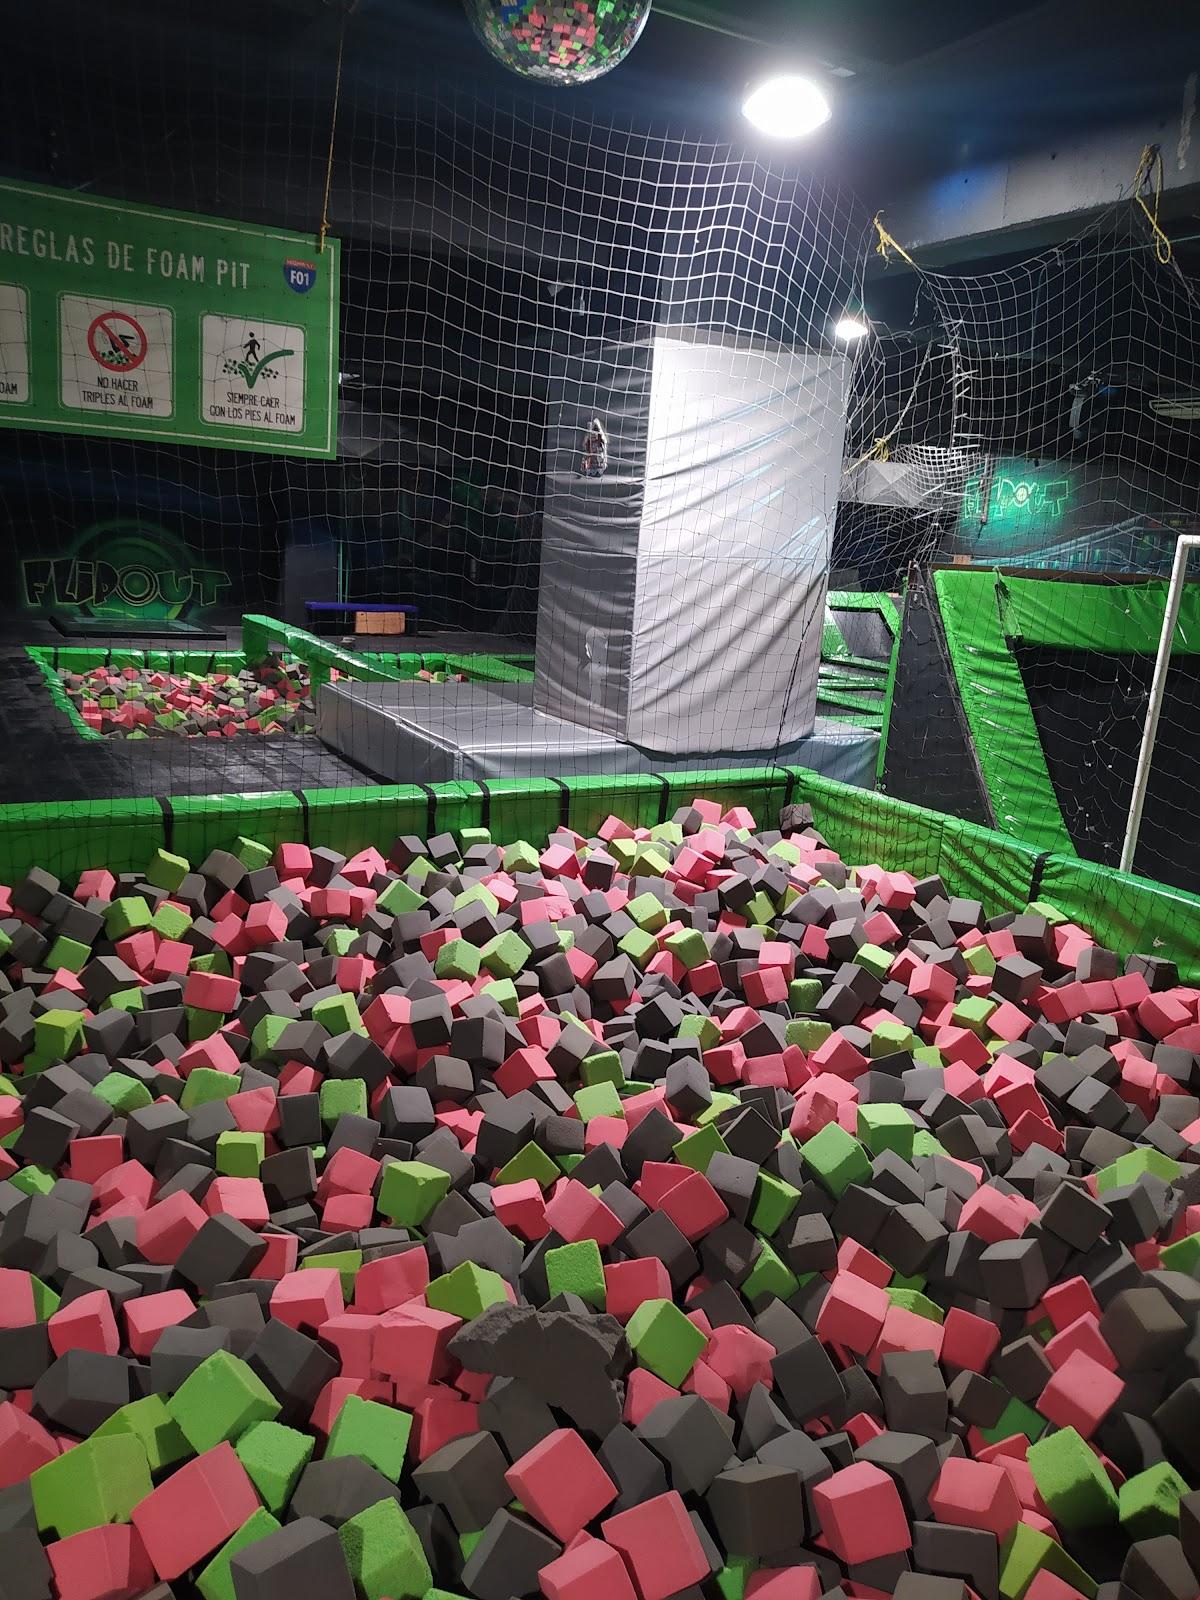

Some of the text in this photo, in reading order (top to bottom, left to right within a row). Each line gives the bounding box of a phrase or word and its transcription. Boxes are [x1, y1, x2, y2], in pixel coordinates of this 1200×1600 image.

[0, 222, 250, 289] REGLAS DE FOAM PIT
[290, 270, 310, 286] F01
[0, 381, 18, 395] OAM
[97, 375, 139, 392] NO HACER
[82, 390, 154, 409] TRIPLES AL FOAM
[226, 391, 280, 409] SIEMPRE CAER
[209, 404, 296, 425] CON LOS PIES AL FOAM
